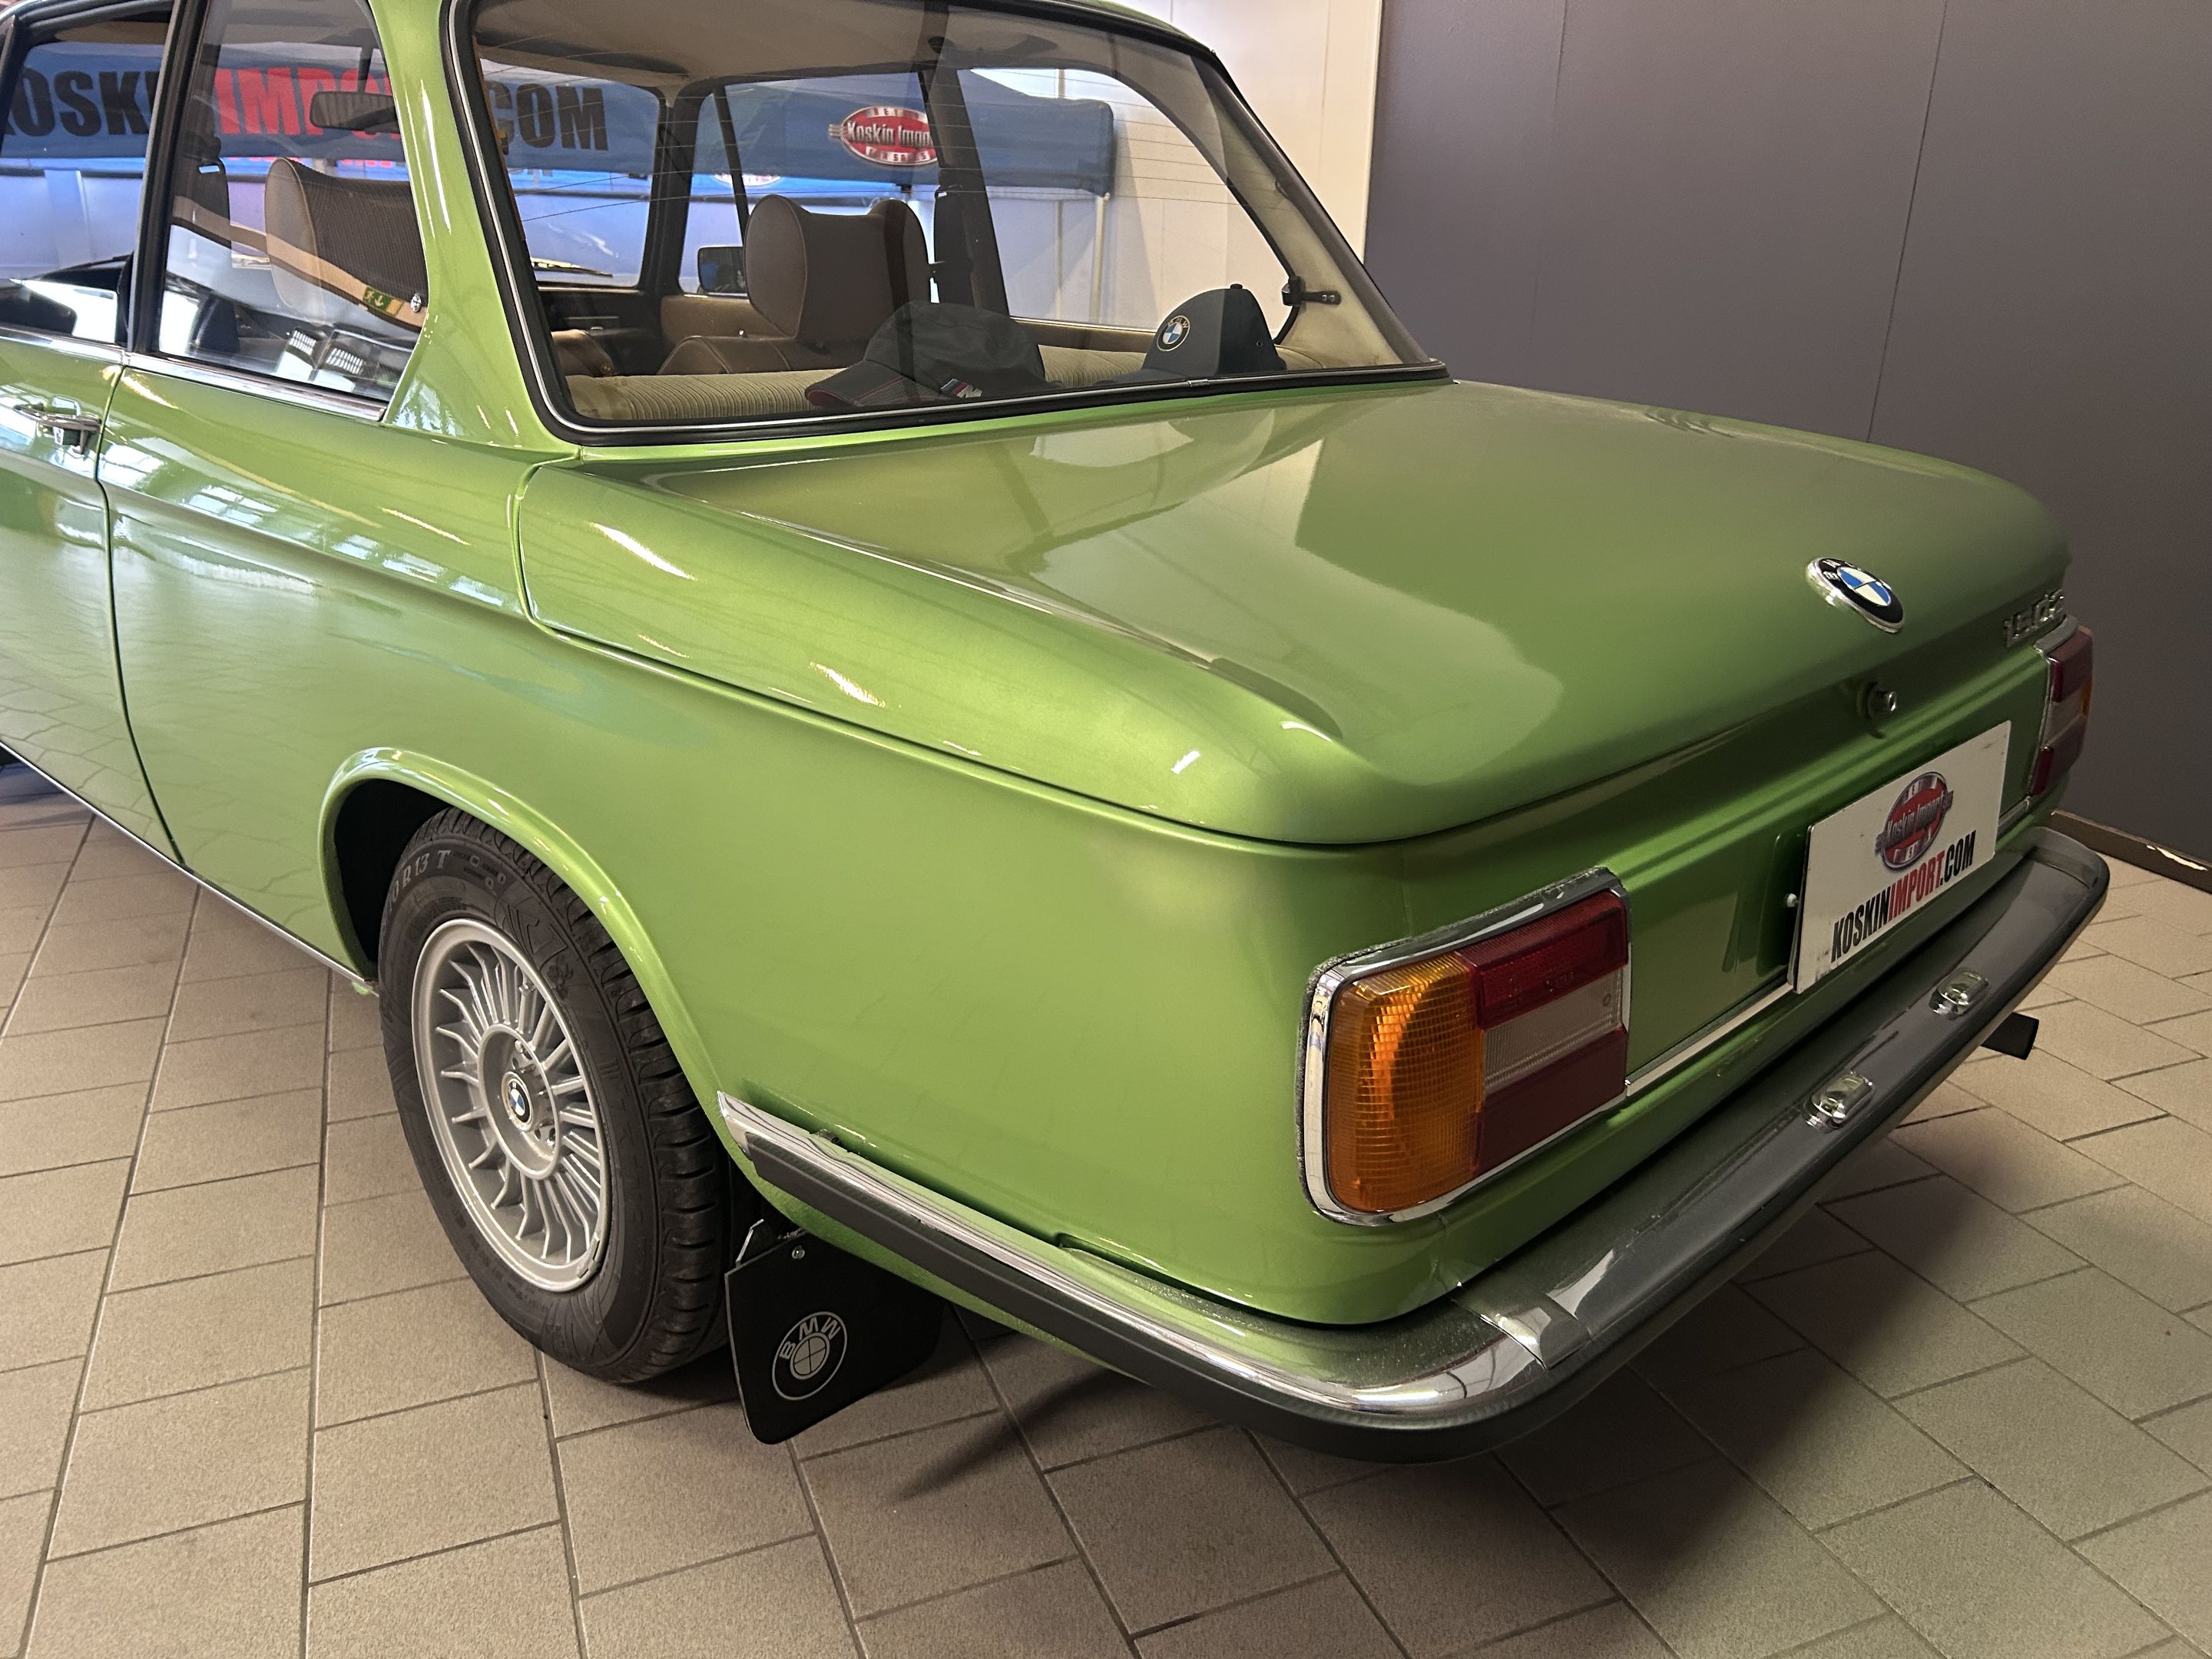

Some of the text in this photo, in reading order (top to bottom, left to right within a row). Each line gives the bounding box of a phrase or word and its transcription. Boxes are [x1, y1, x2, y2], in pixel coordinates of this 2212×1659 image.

[846, 121, 934, 149] Koskin Impo
[436, 849, 451, 869] T
[1830, 830, 1977, 964] KOSKINIMPORT.COM
[779, 1316, 841, 1360] BMW
